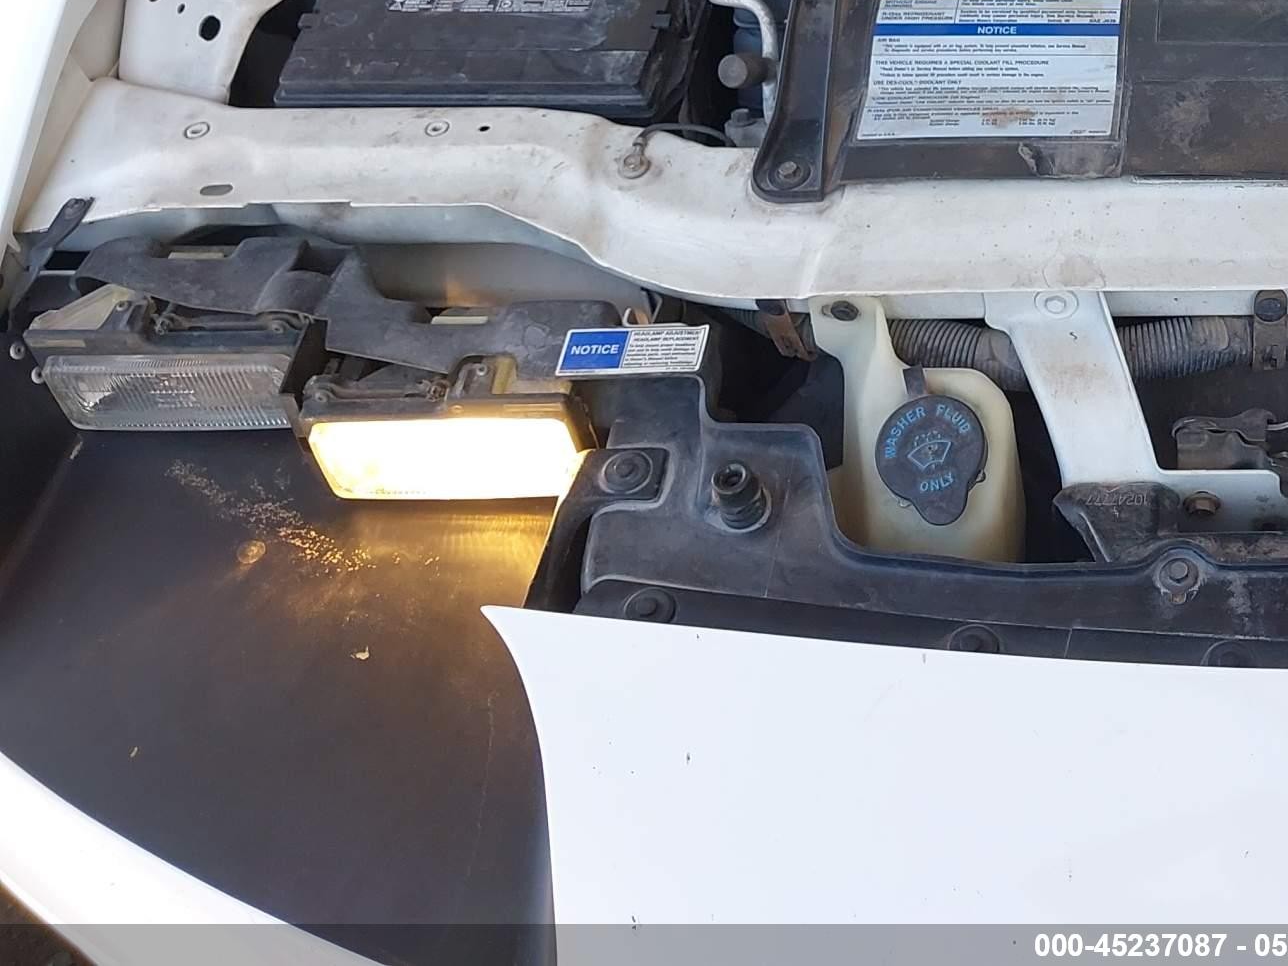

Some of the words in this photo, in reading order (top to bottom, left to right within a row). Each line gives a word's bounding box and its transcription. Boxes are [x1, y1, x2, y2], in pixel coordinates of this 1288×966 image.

[977, 25, 1017, 35] NOTICE
[570, 344, 620, 355] NOTICE
[884, 405, 927, 459] WASHER
[935, 403, 971, 434] FLUID
[919, 471, 954, 492] ONLY
